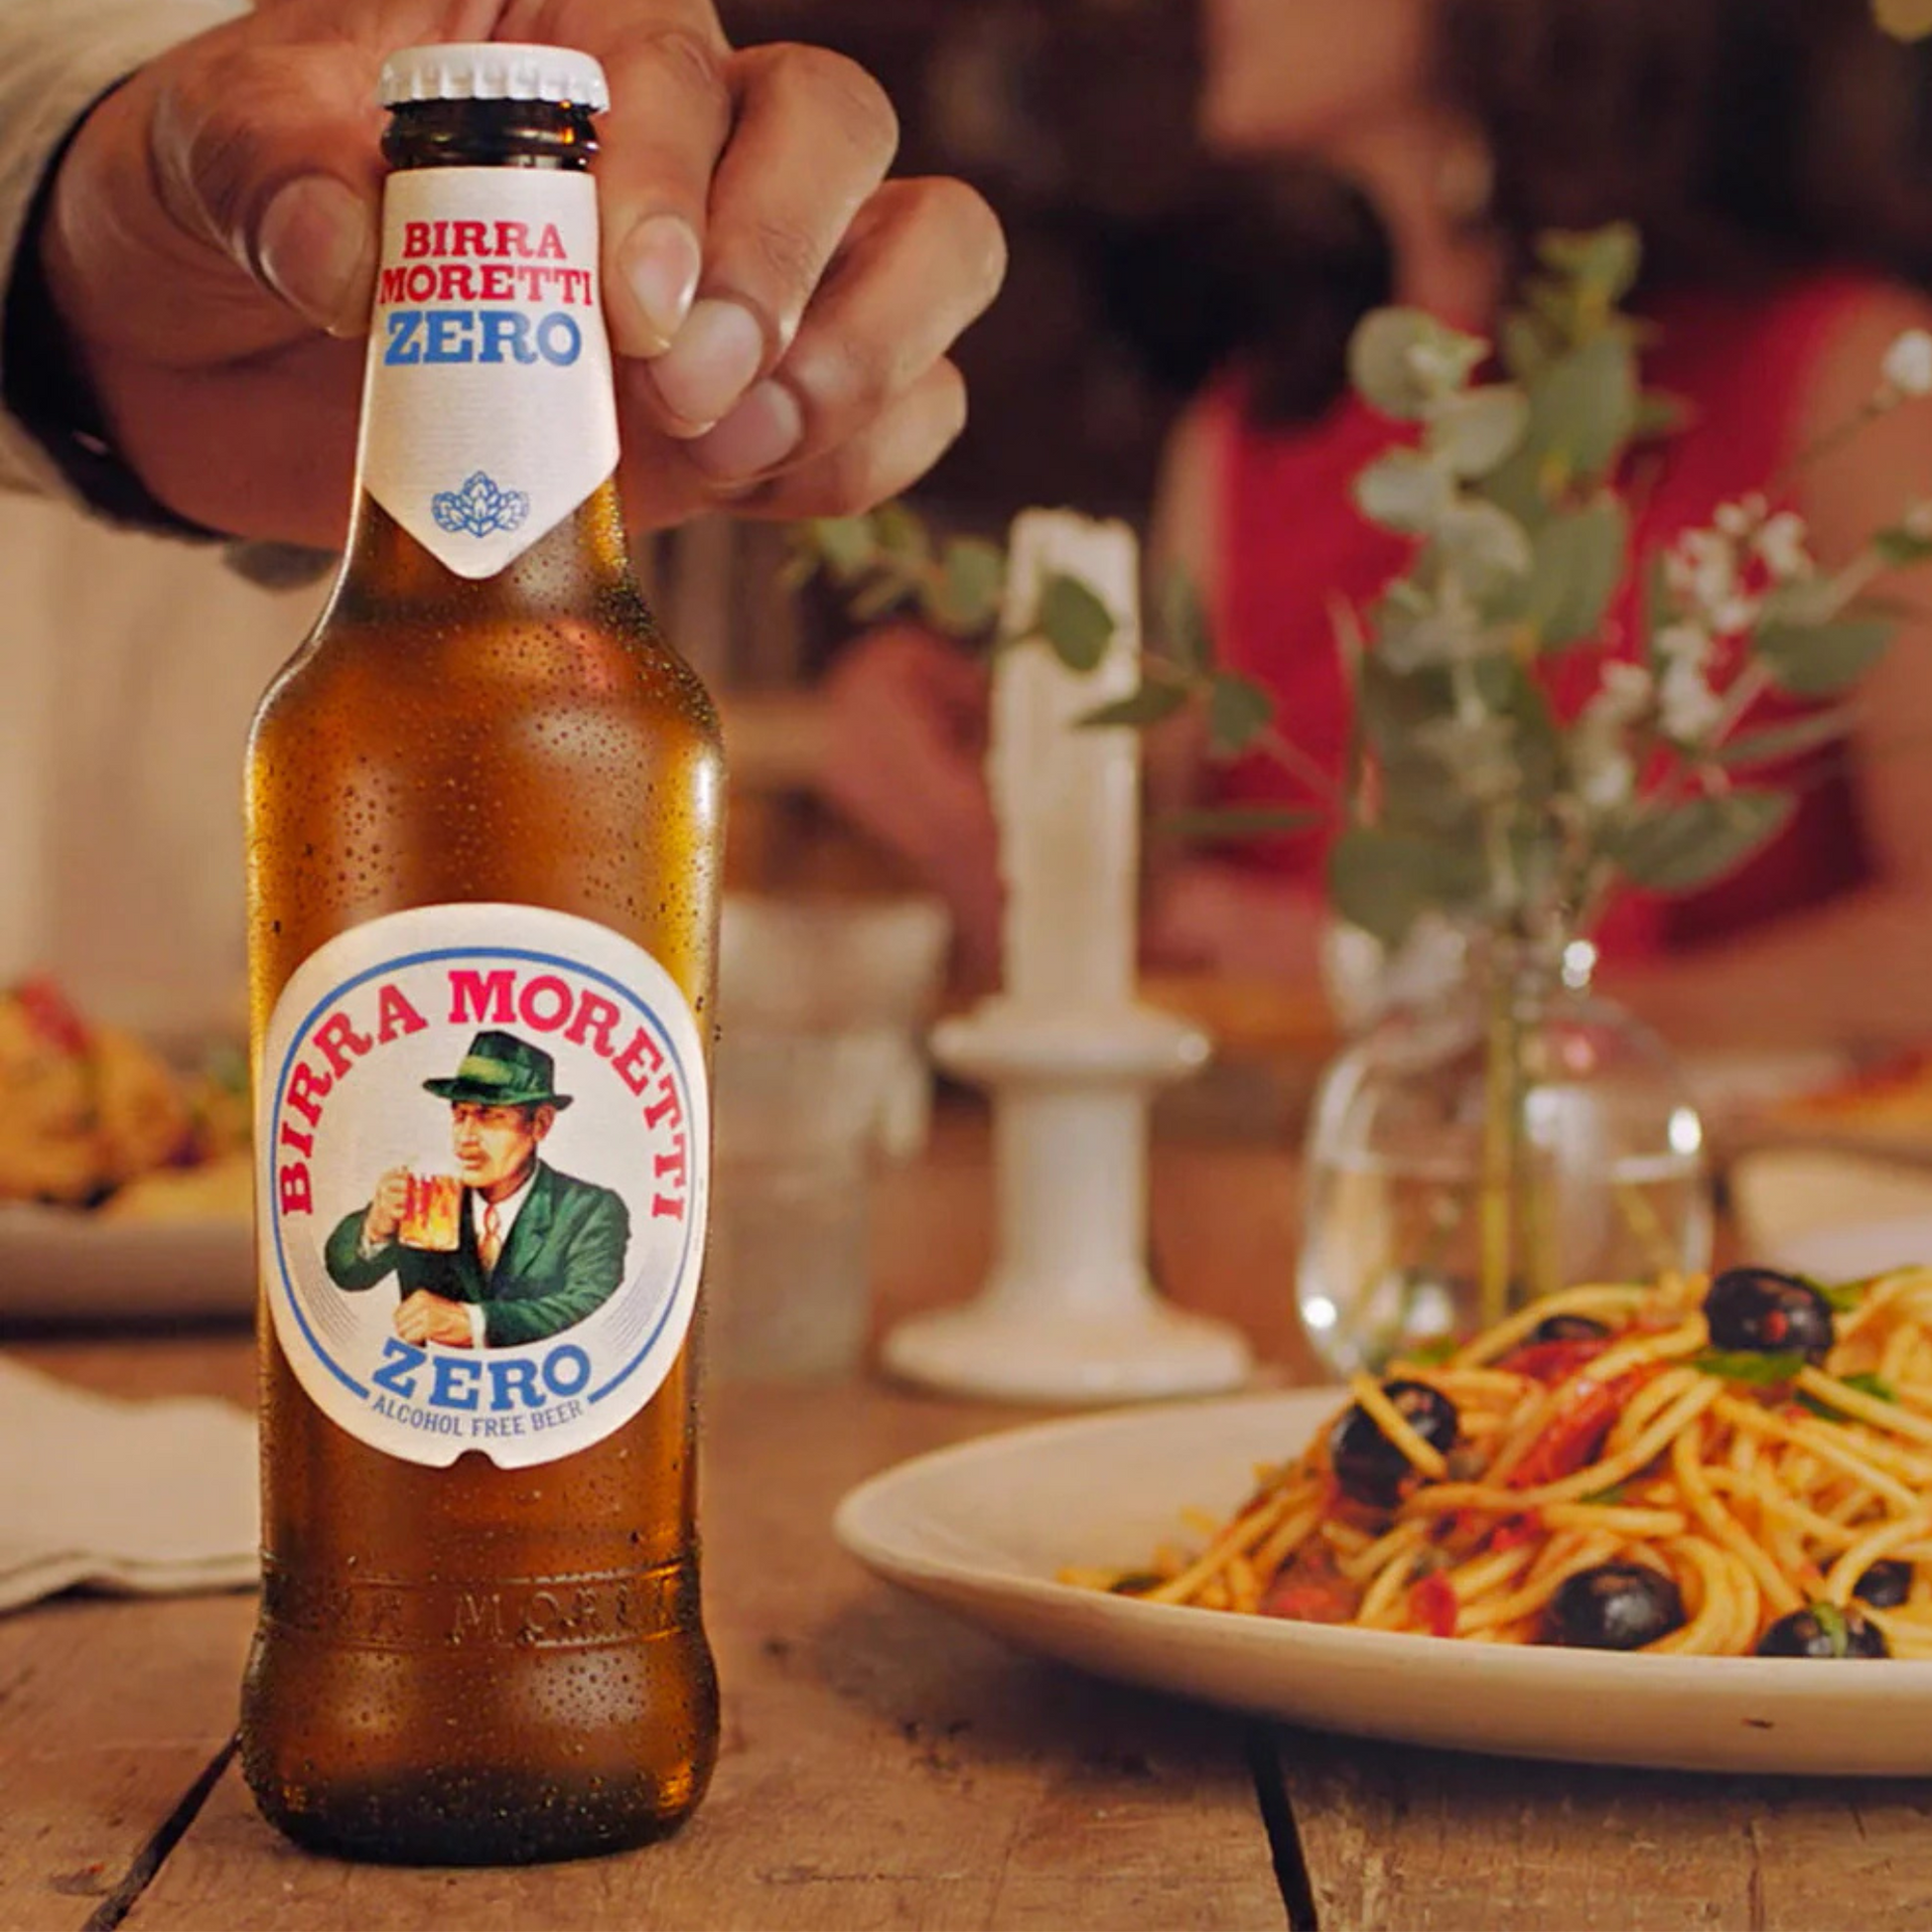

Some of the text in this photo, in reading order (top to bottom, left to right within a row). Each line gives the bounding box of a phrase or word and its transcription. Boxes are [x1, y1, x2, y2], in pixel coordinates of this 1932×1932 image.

[402, 220, 567, 260] BIRRA
[380, 263, 593, 306] MORETTI
[384, 310, 582, 366] ZERO
[280, 969, 687, 1222] BIRRA MORETTI
[371, 1337, 592, 1412] ZERO
[372, 1394, 584, 1439] ALCOHOL FREE BEER
